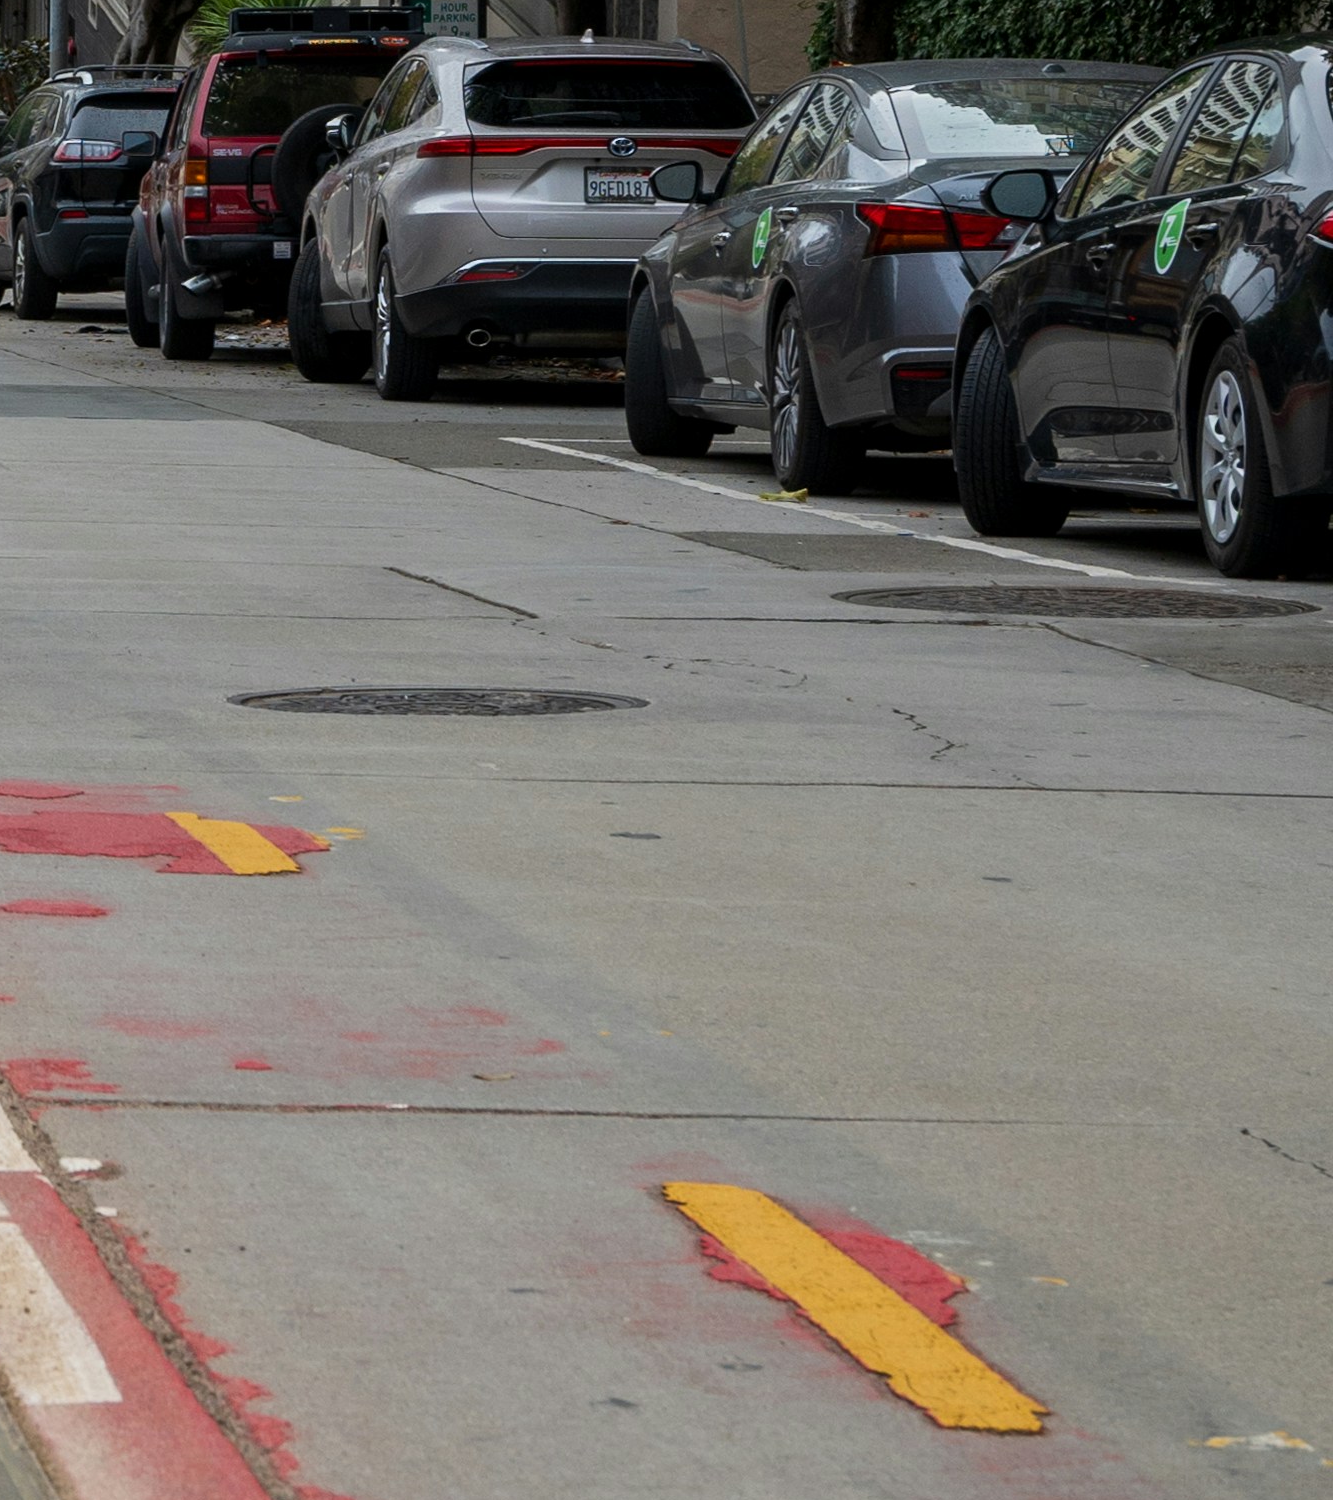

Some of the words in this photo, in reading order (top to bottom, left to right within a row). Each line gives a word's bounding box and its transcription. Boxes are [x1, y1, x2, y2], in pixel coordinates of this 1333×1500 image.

[440, 2, 469, 13] HOUR
[433, 13, 477, 23] PARKING
[451, 25, 459, 36] 9
[589, 180, 651, 197] 9GED187
